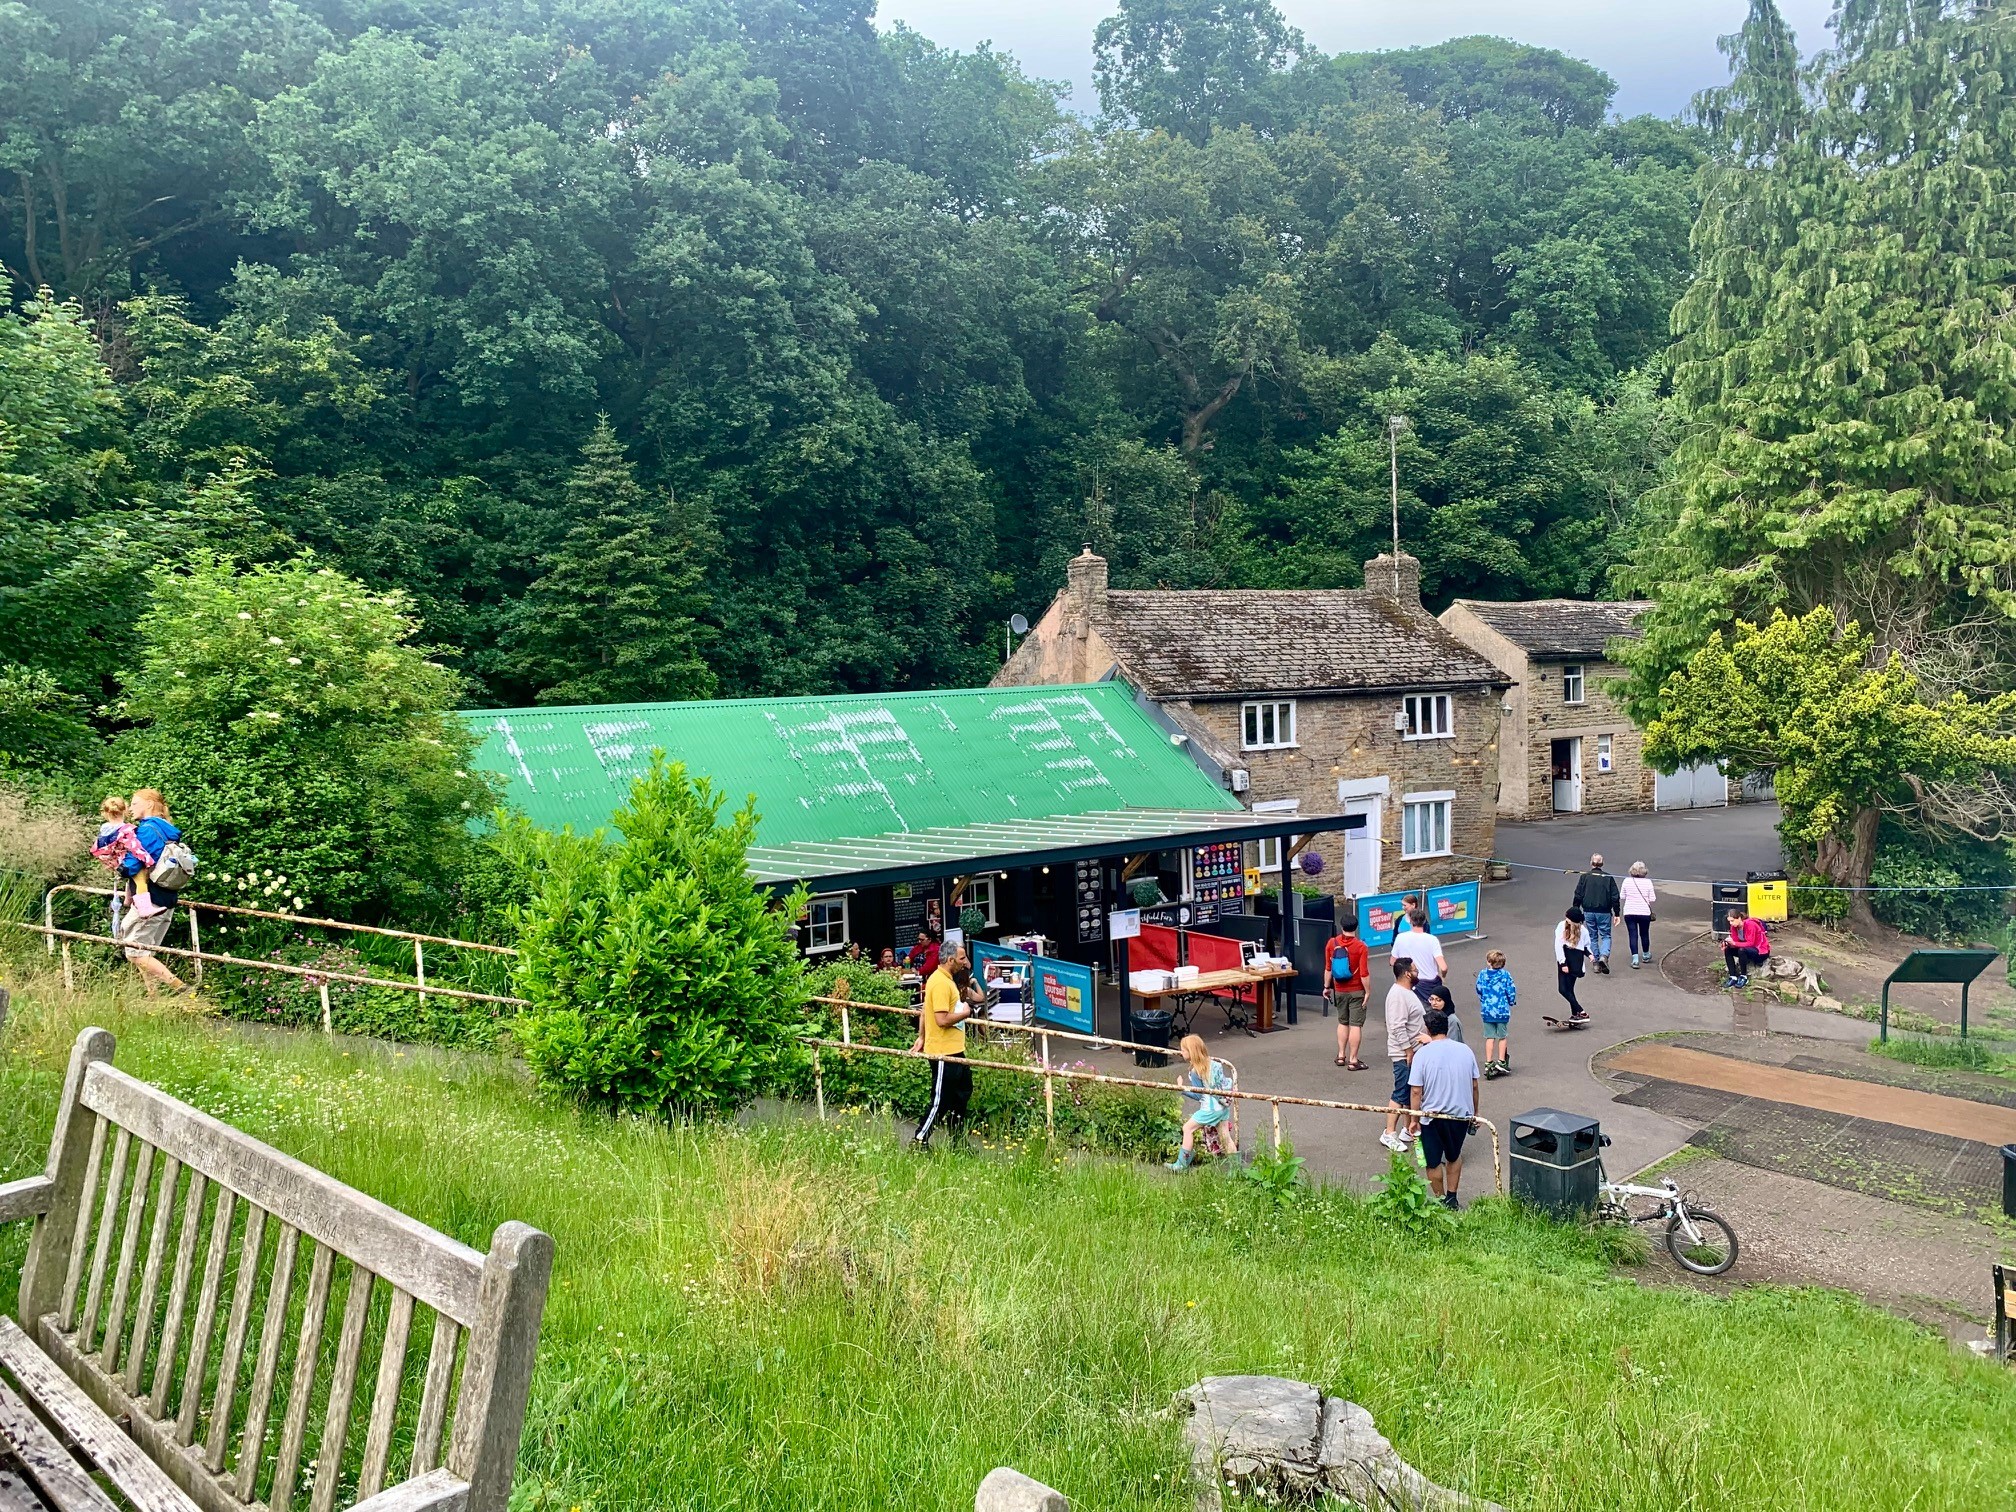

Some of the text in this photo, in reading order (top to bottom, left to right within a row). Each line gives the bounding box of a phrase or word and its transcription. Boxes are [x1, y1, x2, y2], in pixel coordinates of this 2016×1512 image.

[1369, 908, 1382, 916] make
[1370, 912, 1392, 926] yourself
[1044, 985, 1066, 997] yourself
[1051, 995, 1067, 1007] home
